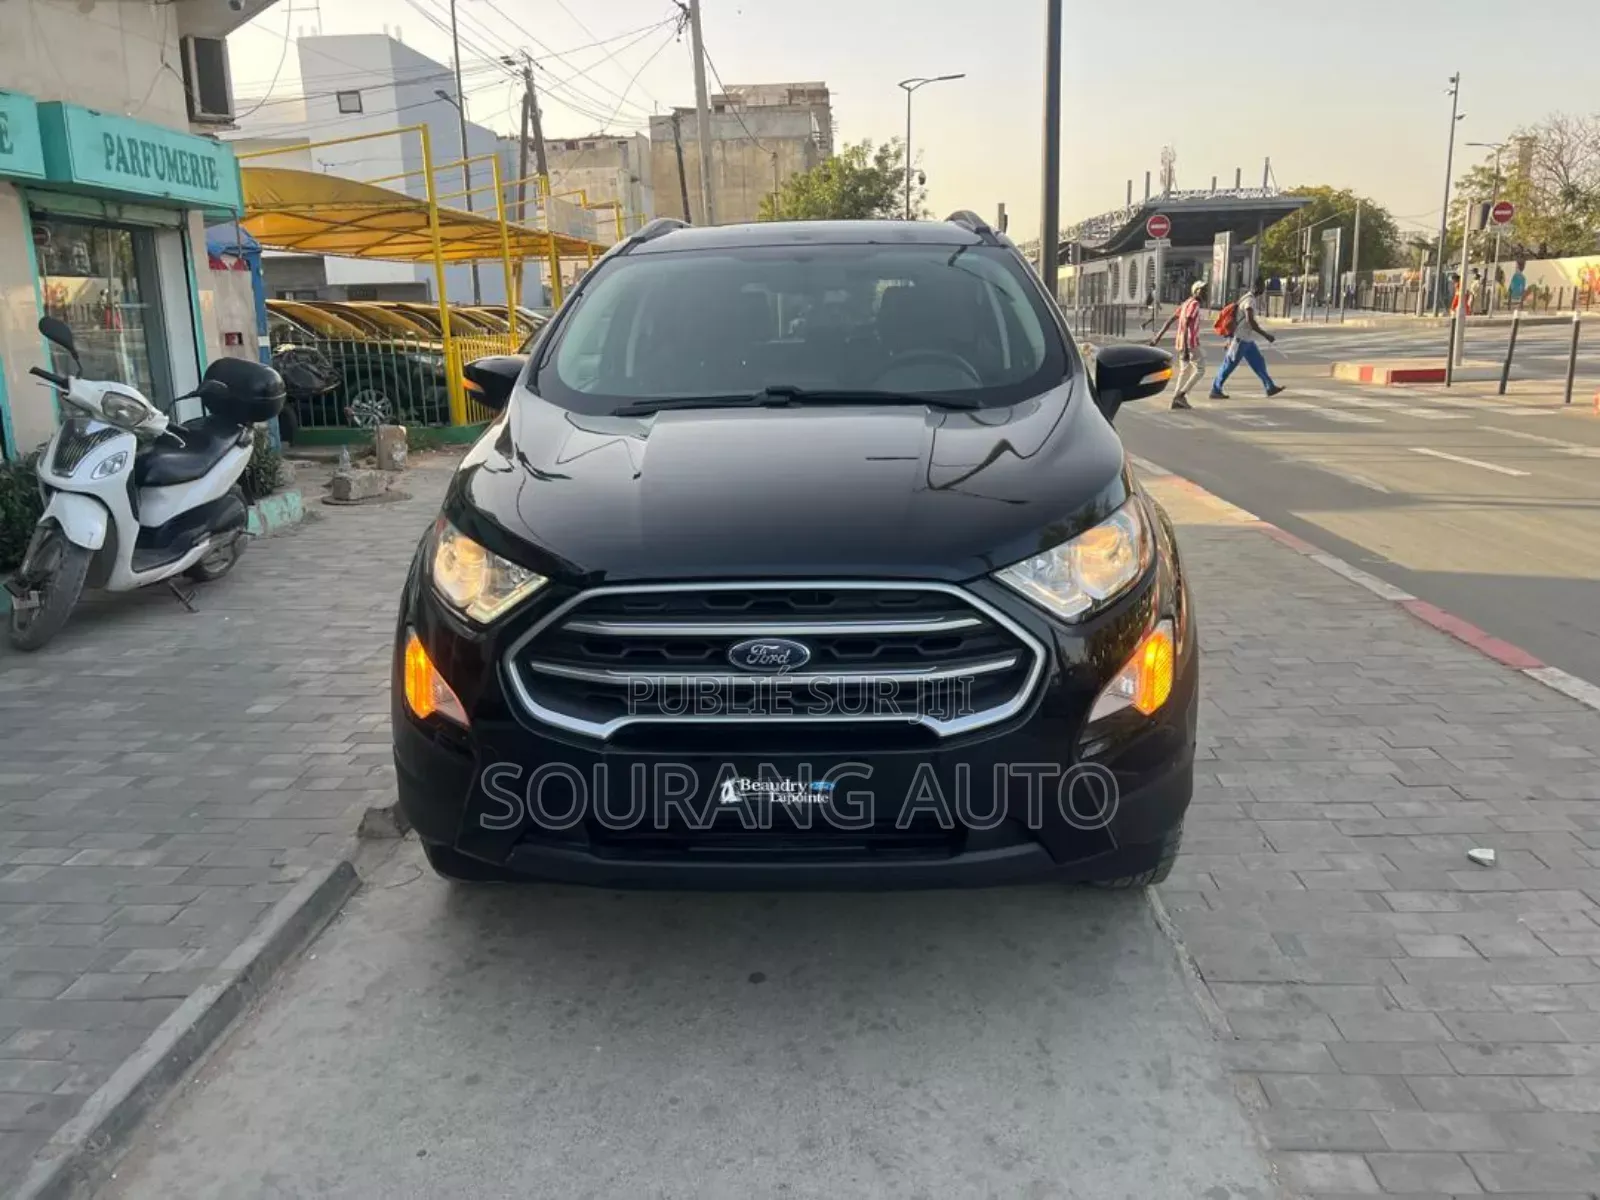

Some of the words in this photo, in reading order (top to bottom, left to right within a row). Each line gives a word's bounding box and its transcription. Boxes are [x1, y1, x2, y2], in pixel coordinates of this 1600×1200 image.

[102, 132, 219, 192] PARFUMERIE
[746, 644, 791, 665] Ford
[740, 778, 807, 793] Beaudry
[770, 791, 830, 805] Lapointe
